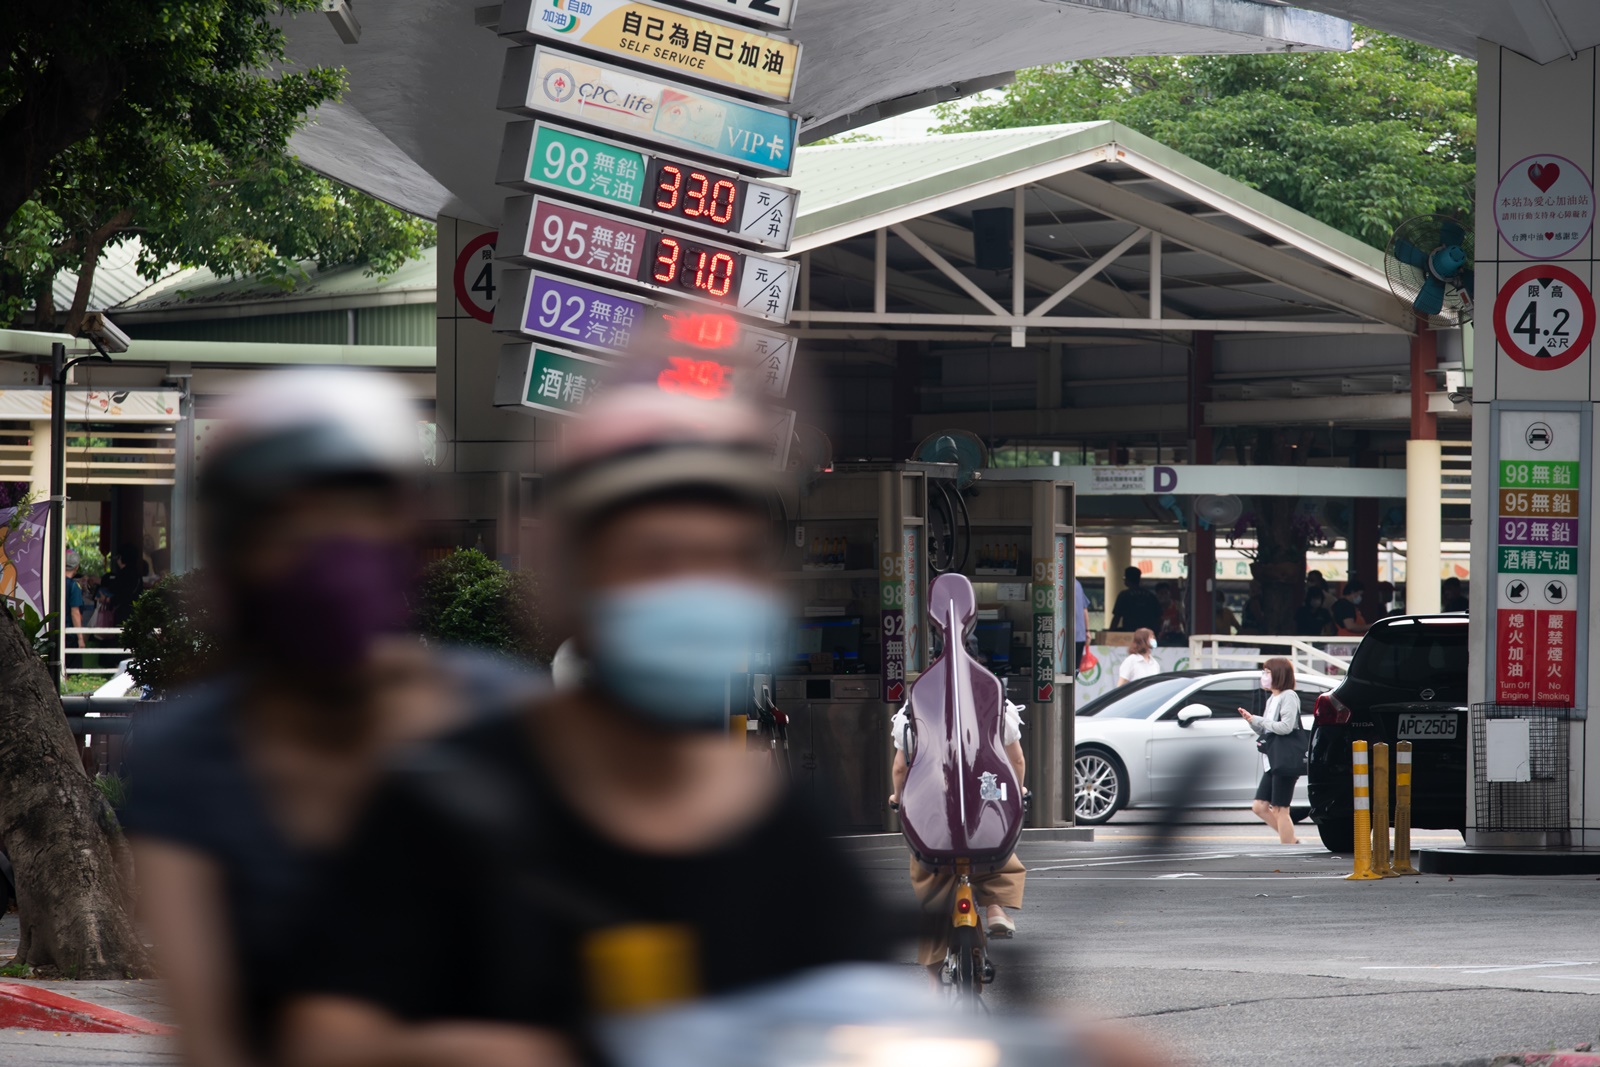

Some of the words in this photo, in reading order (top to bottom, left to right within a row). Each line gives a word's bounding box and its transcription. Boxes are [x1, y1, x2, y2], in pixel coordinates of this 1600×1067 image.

[542, 9, 567, 26] 加油
[568, 0, 592, 16] 自助
[619, 38, 651, 57] SELF
[653, 47, 706, 70] SERVICE
[622, 11, 784, 75] 自己為自己加油
[543, 141, 589, 185] 98
[657, 165, 736, 224] 33.0
[1501, 195, 1588, 207] 本站為愛心加油站
[541, 215, 588, 260] 95
[654, 238, 734, 296] 31.0
[539, 290, 585, 335] 92
[1513, 301, 1570, 345] 4.2
[1547, 338, 1569, 348] 公尺
[1153, 467, 1178, 492] D
[882, 556, 904, 577] 95
[1035, 562, 1055, 582] 95
[1504, 550, 1570, 570] 酒精汽油
[884, 616, 905, 636] 92
[1037, 616, 1053, 681] 酒精汽油
[1508, 613, 1524, 677] 熄火加油
[1547, 614, 1563, 678] 嚴禁煙火
[886, 640, 904, 680] 無鉛
[1500, 681, 1516, 689] Turn
[1518, 681, 1530, 689] Off
[1502, 691, 1529, 700] Engine
[1538, 692, 1570, 701] Smoking
[1548, 682, 1561, 690] No
